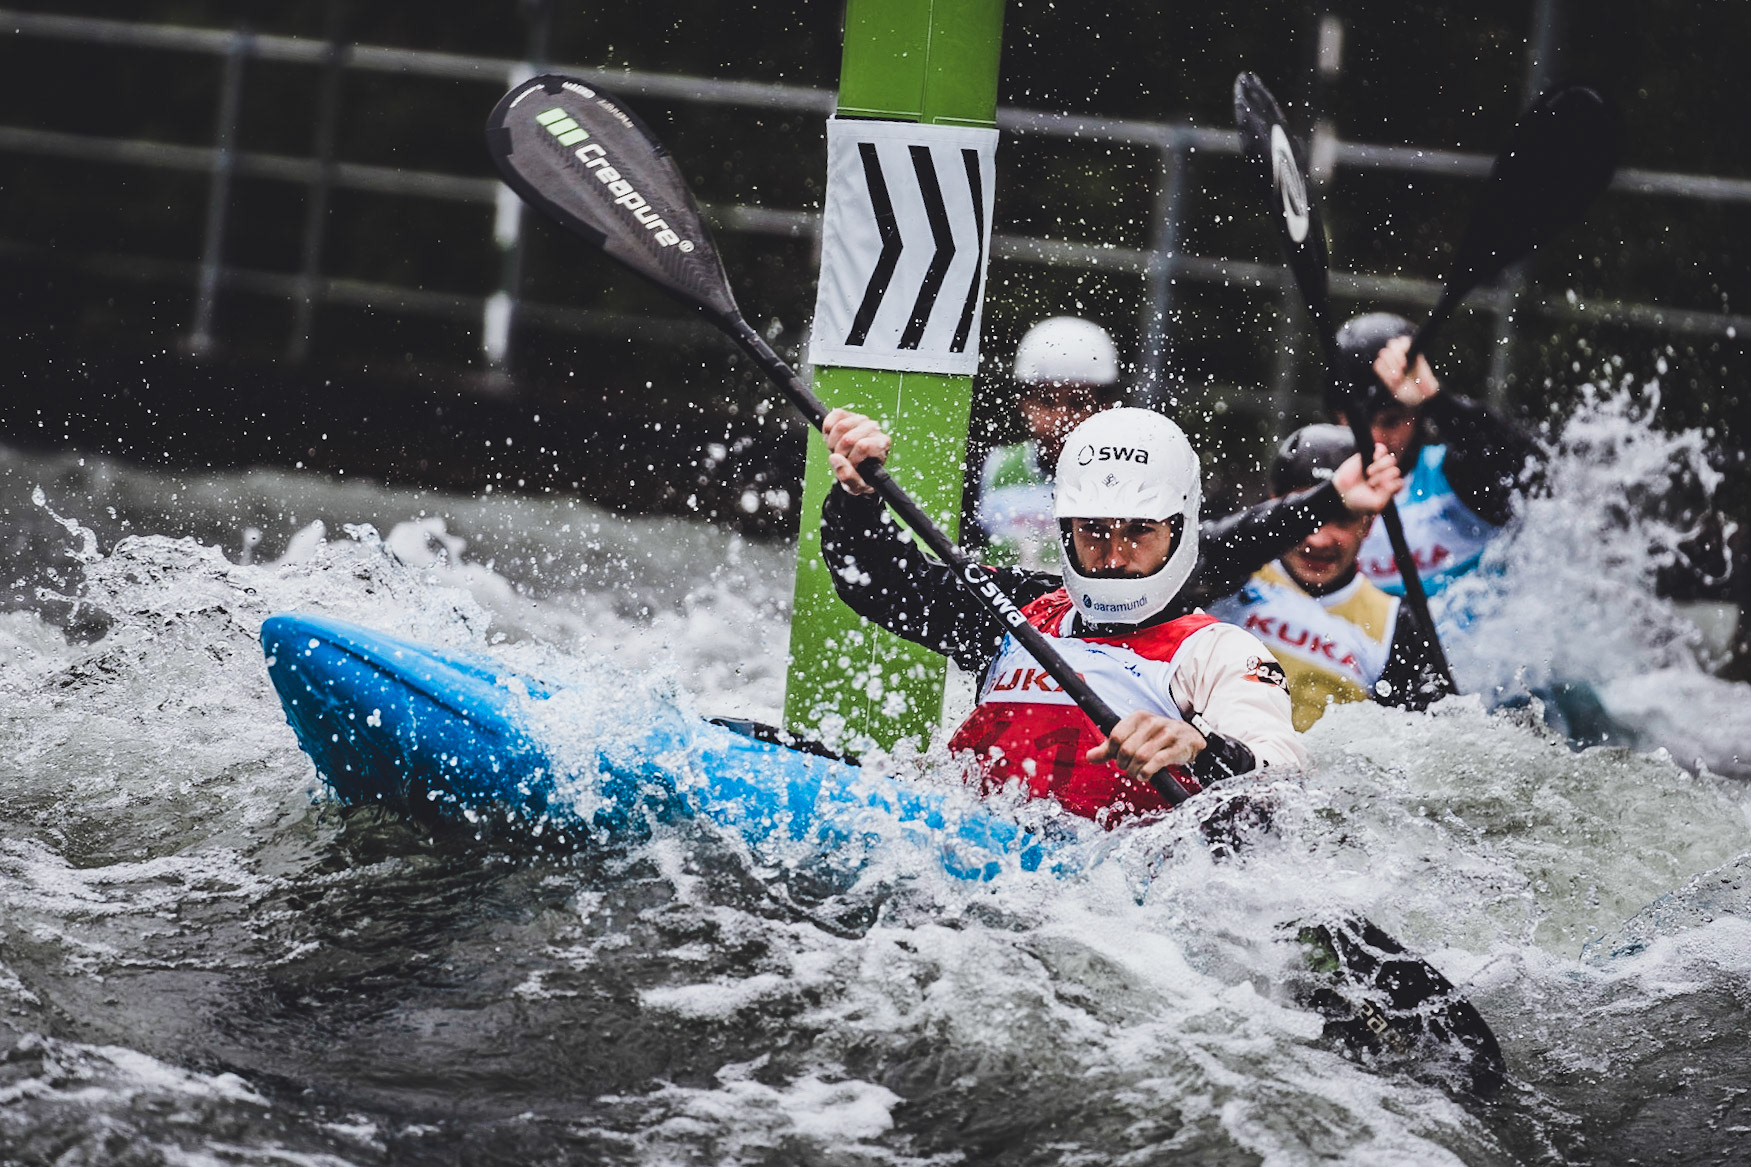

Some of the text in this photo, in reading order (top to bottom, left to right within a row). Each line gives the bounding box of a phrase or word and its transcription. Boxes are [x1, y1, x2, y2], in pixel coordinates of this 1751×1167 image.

[1098, 446, 1149, 465] swa
[980, 581, 1028, 628] swa
[1244, 612, 1364, 677] KUKA
